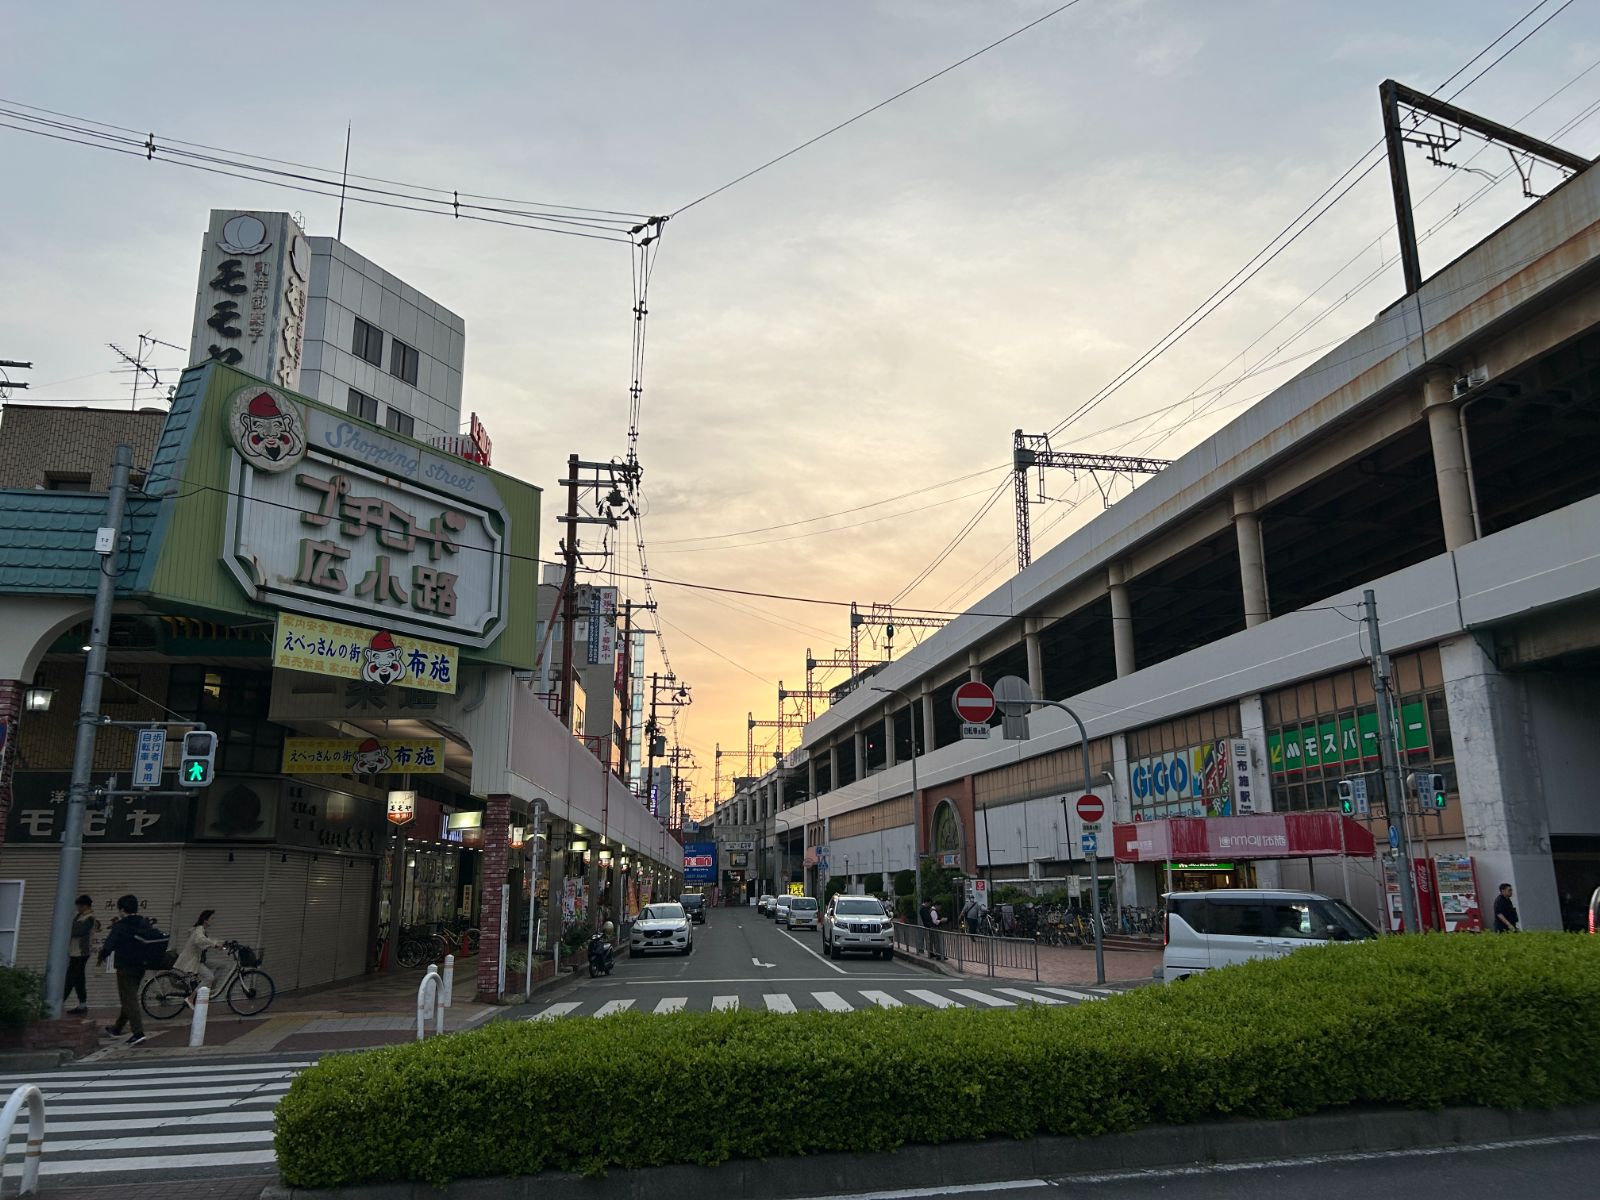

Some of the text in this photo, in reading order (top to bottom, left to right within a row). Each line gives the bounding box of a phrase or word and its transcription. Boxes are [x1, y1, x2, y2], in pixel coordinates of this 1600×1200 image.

[325, 422, 476, 492] Shopping street
[296, 474, 466, 560] プチロード
[294, 538, 458, 616] 広小路
[283, 631, 451, 683] えべっさんの街 布施
[143, 762, 154, 782] 専用
[290, 745, 436, 766] えべっさんの街 布施
[1237, 760, 1252, 803] 布施駅
